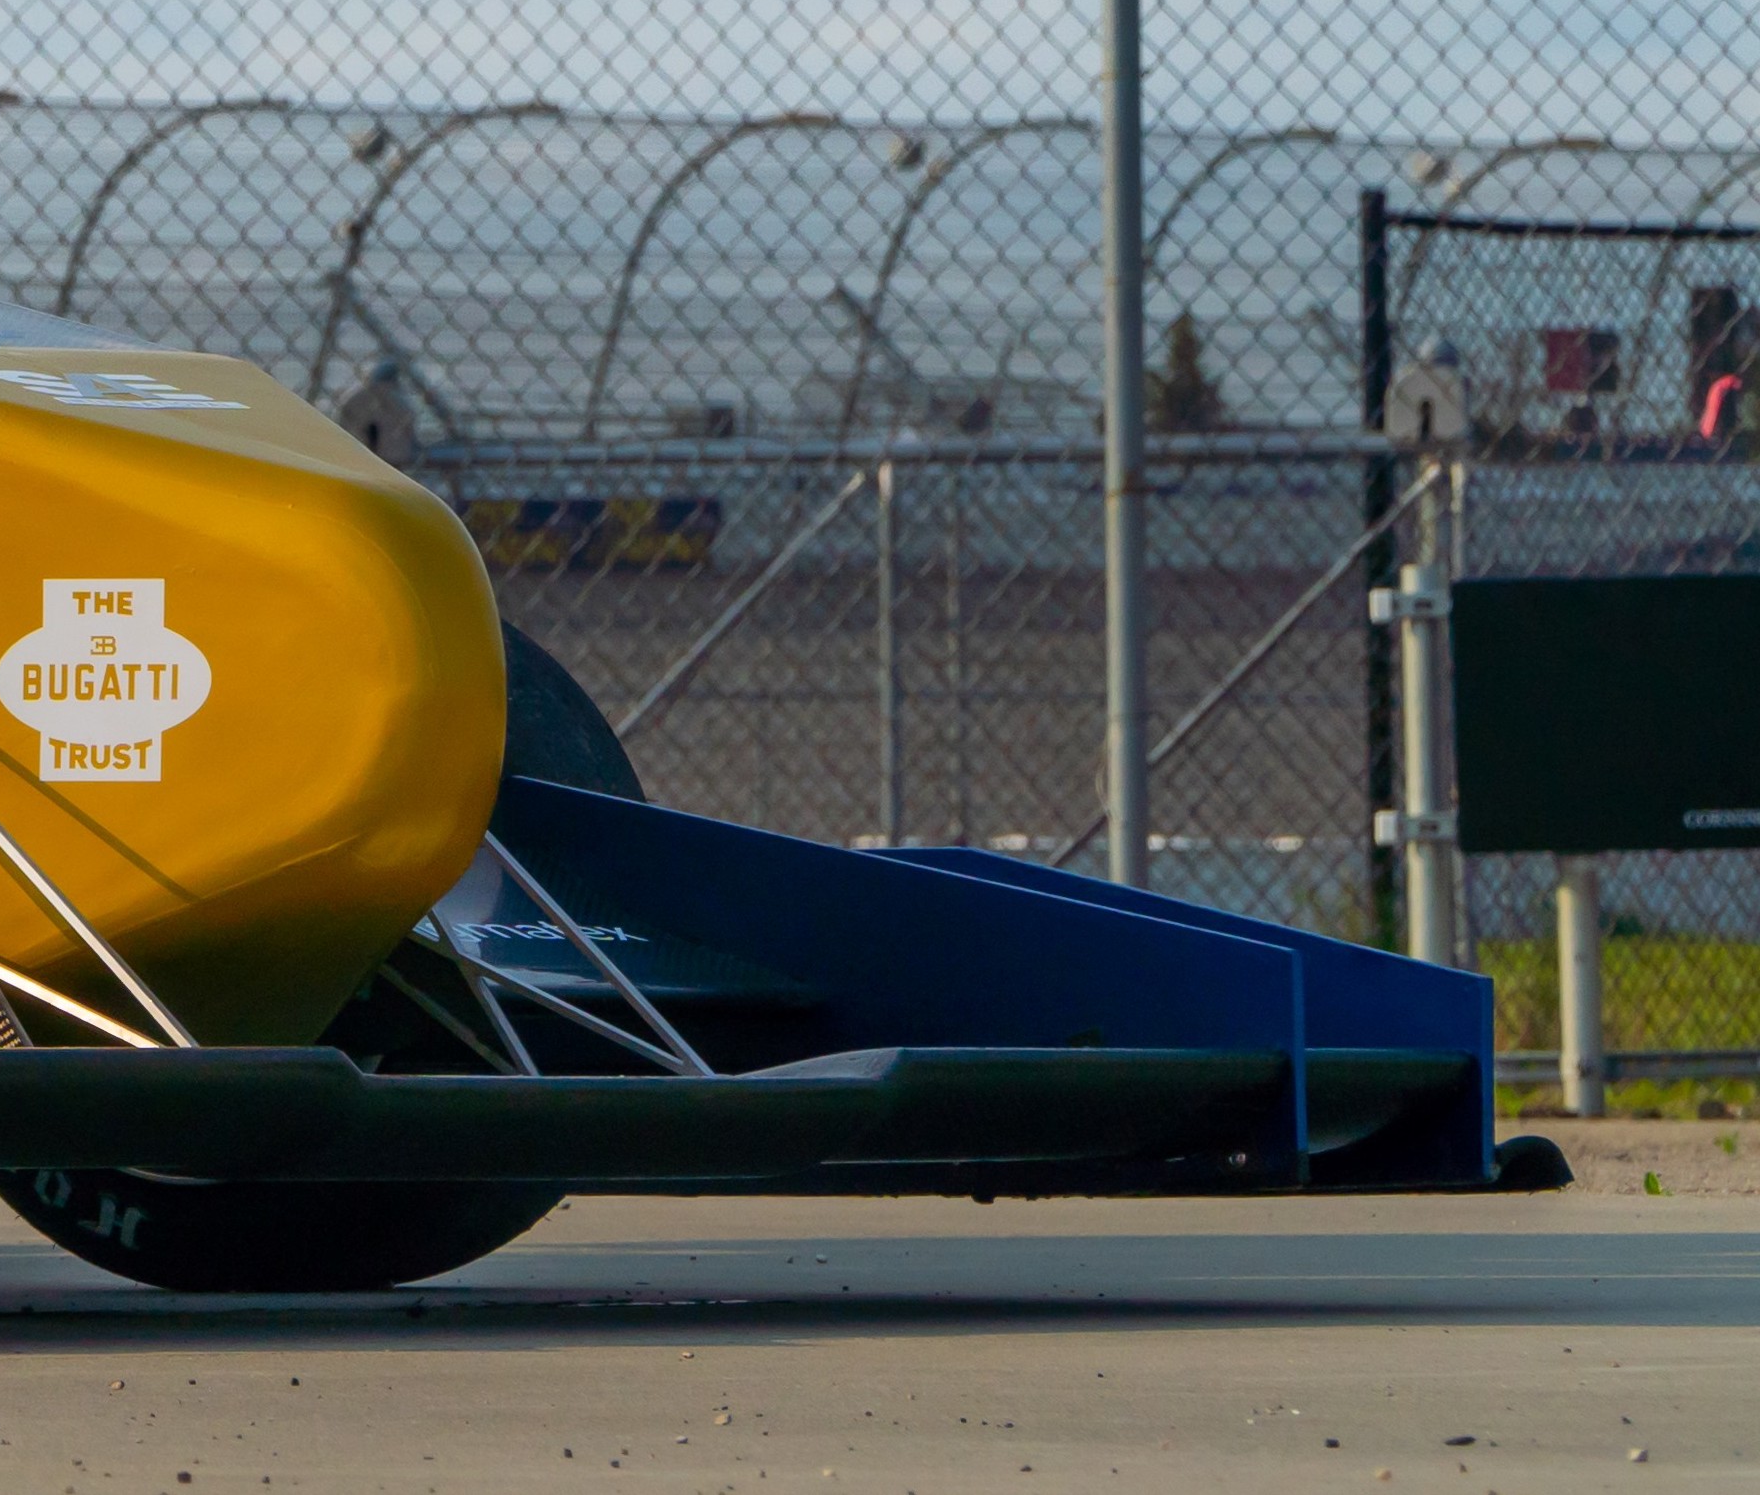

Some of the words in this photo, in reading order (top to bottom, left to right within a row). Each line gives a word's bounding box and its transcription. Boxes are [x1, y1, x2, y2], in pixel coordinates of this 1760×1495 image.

[72, 591, 133, 616] THE
[22, 664, 180, 702] BUGATTI
[49, 738, 153, 770] TRUST
